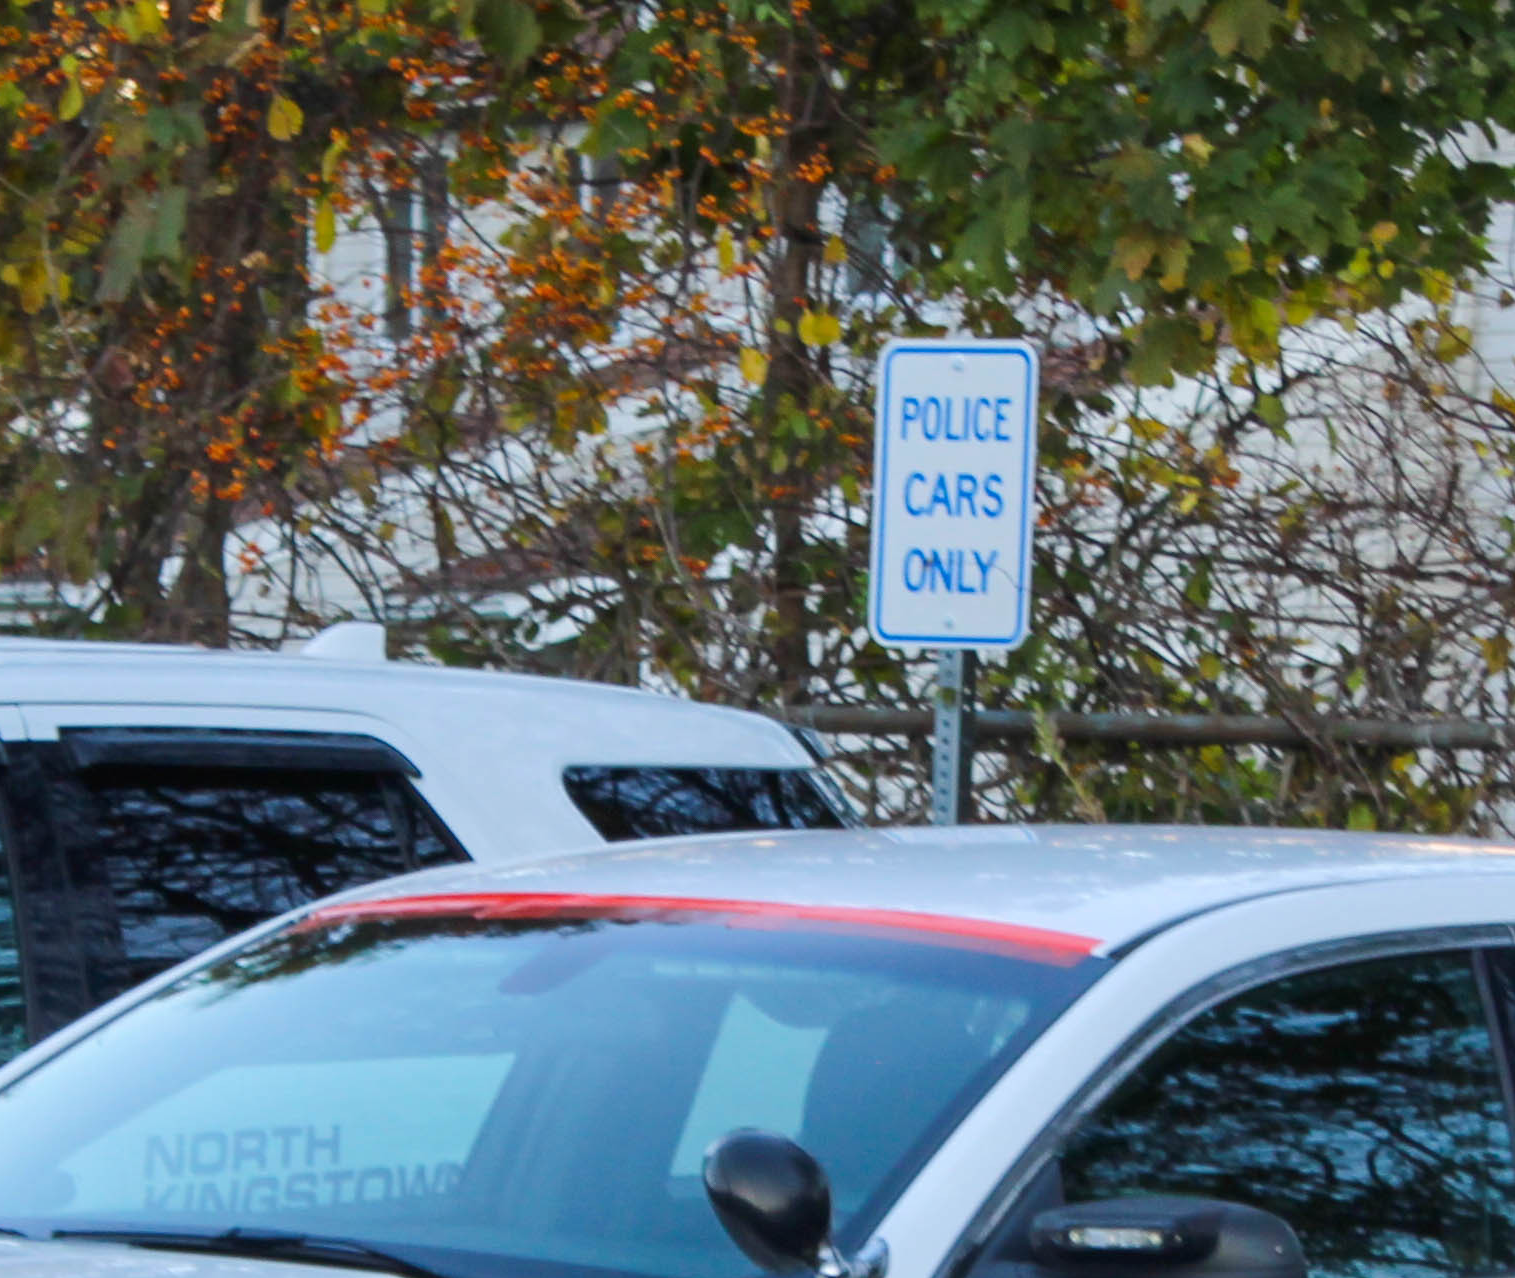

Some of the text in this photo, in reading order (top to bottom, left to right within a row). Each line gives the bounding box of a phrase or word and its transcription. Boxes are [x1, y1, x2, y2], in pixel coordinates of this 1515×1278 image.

[900, 396, 1012, 442] POLICE
[904, 472, 1004, 518] CARS
[903, 547, 999, 593] ONLY
[144, 1124, 341, 1179] NORTH
